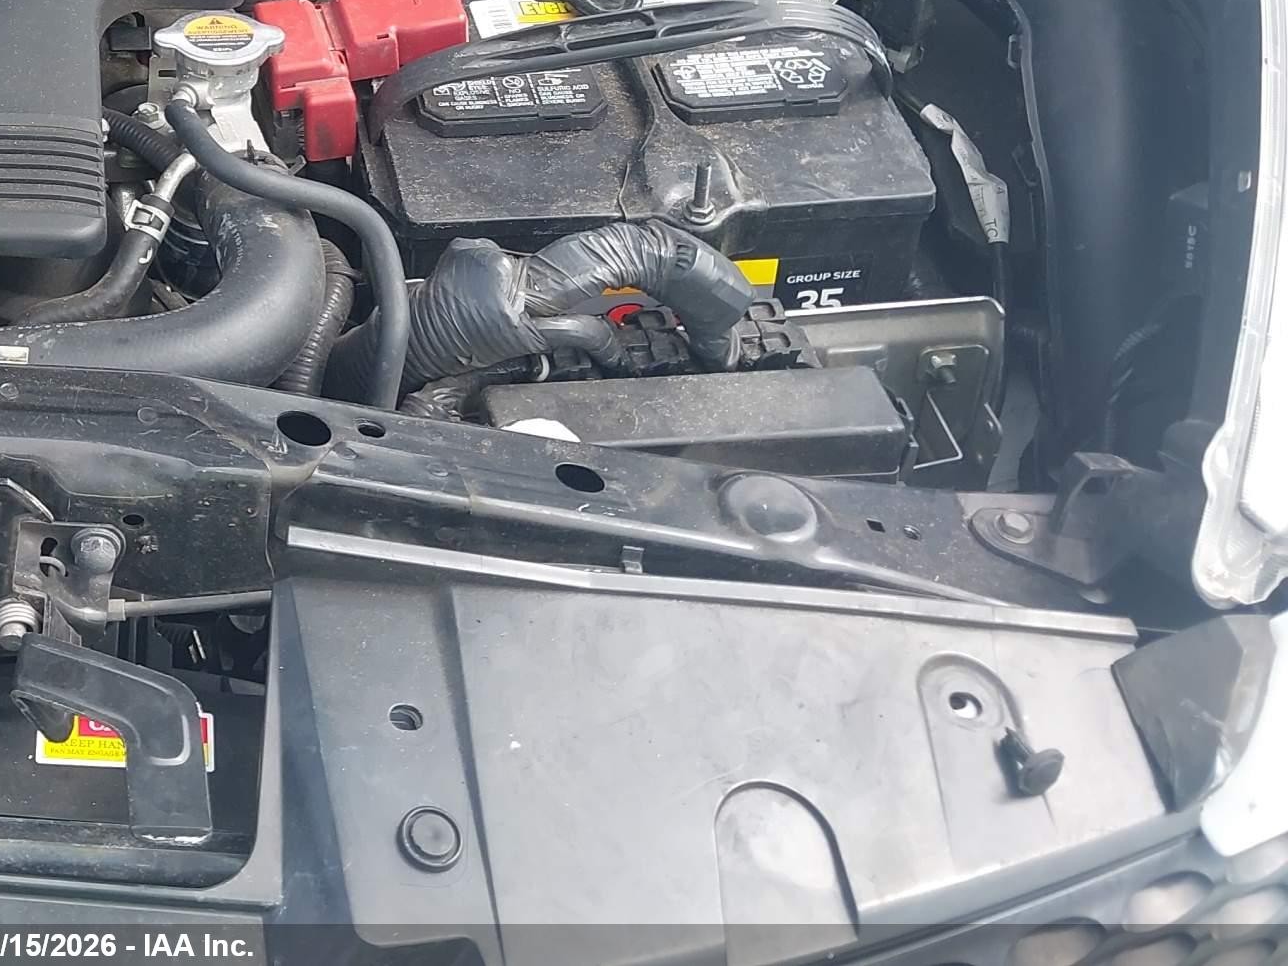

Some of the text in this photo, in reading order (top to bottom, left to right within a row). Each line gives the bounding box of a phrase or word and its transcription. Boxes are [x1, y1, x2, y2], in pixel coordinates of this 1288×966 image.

[518, 1, 570, 16] Ever
[786, 269, 861, 284] GROUP SIZE
[796, 287, 844, 310] 35
[98, 740, 126, 749] HAN
[87, 749, 120, 757] ENGAGE
